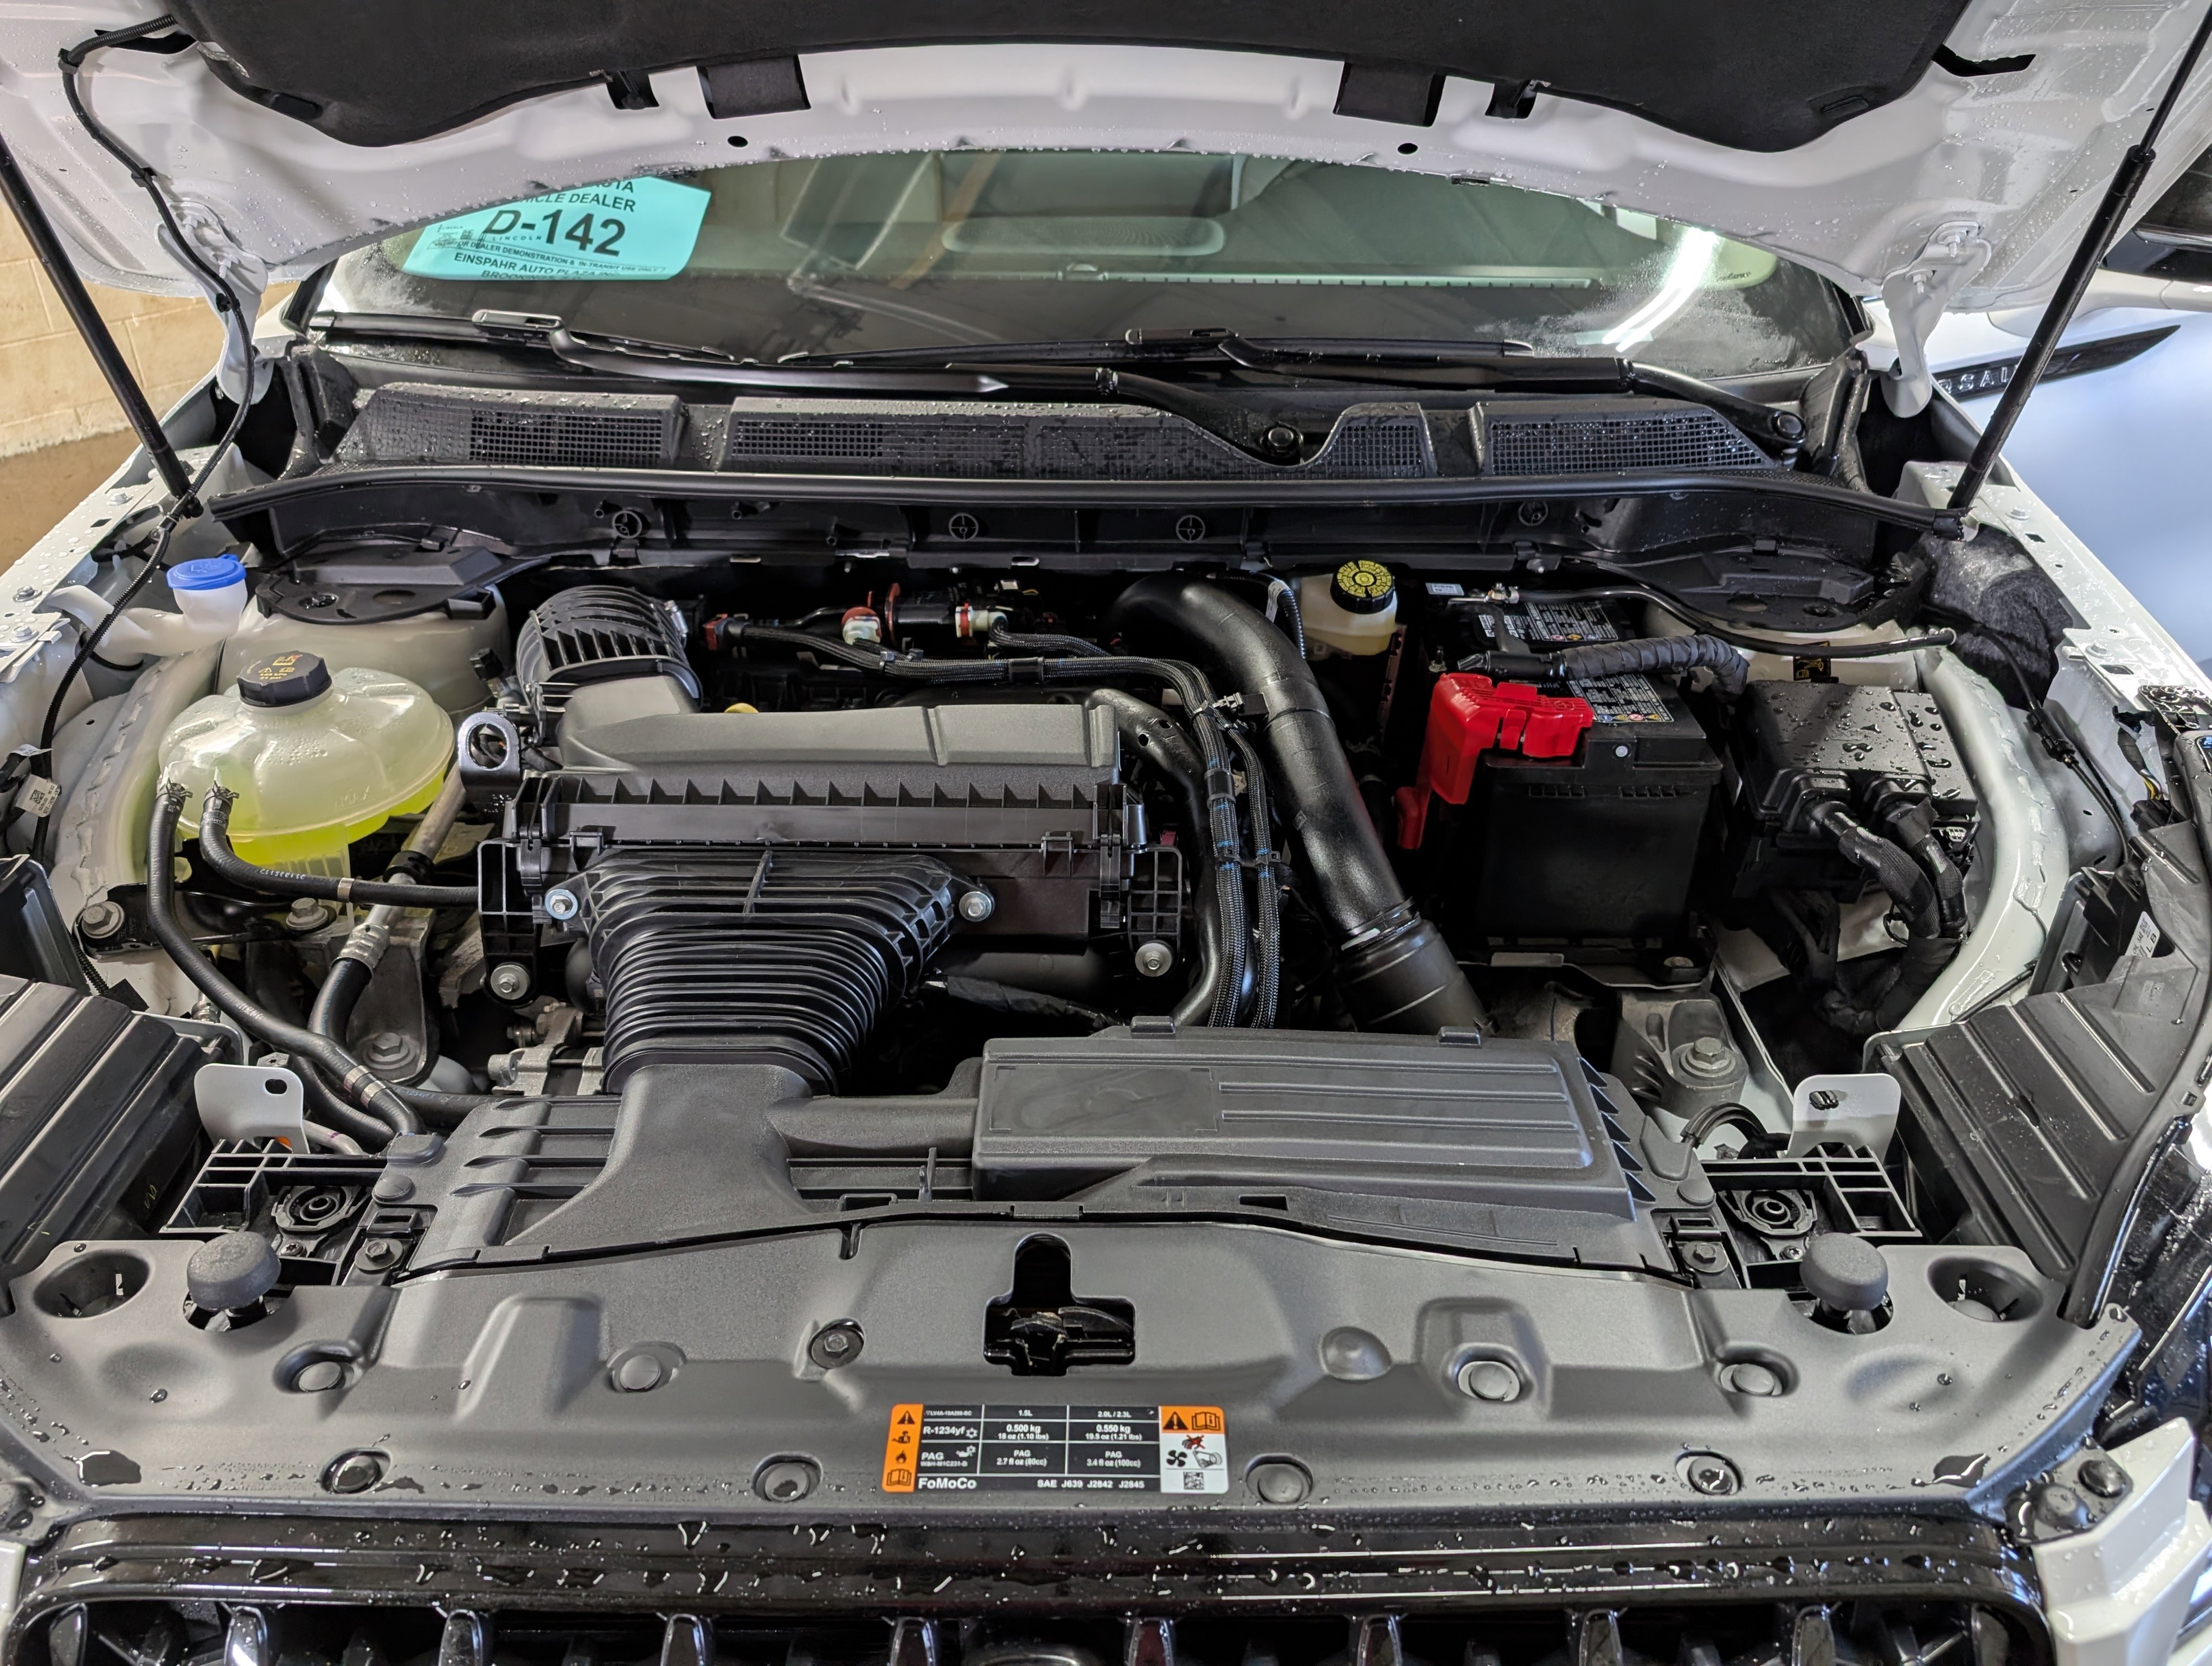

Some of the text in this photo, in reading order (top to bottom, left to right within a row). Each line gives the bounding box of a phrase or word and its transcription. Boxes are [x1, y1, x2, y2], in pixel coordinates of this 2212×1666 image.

[569, 193, 636, 213] DEALER
[484, 209, 626, 257] D-142
[454, 252, 517, 271] EINSPAHR
[518, 264, 554, 274] AUTO
[502, 247, 568, 265] DEMONSTRATION
[578, 261, 620, 271] IN-TRANSIT
[923, 1426, 966, 1436] R-1234yf
[1006, 1424, 1041, 1434] 0.500 kg
[1096, 1424, 1131, 1434] 0.550 kg
[922, 1452, 944, 1460] PAG
[996, 1457, 1008, 1465] 2.7
[1008, 1457, 1014, 1465] fl
[1025, 1458, 1047, 1467] (80cc)
[1086, 1458, 1098, 1466] 3.4
[1115, 1459, 1141, 1468] (100cc)
[918, 1477, 977, 1489] FoMoCo
[1037, 1479, 1145, 1489] SAE J639 J2842 J2845
